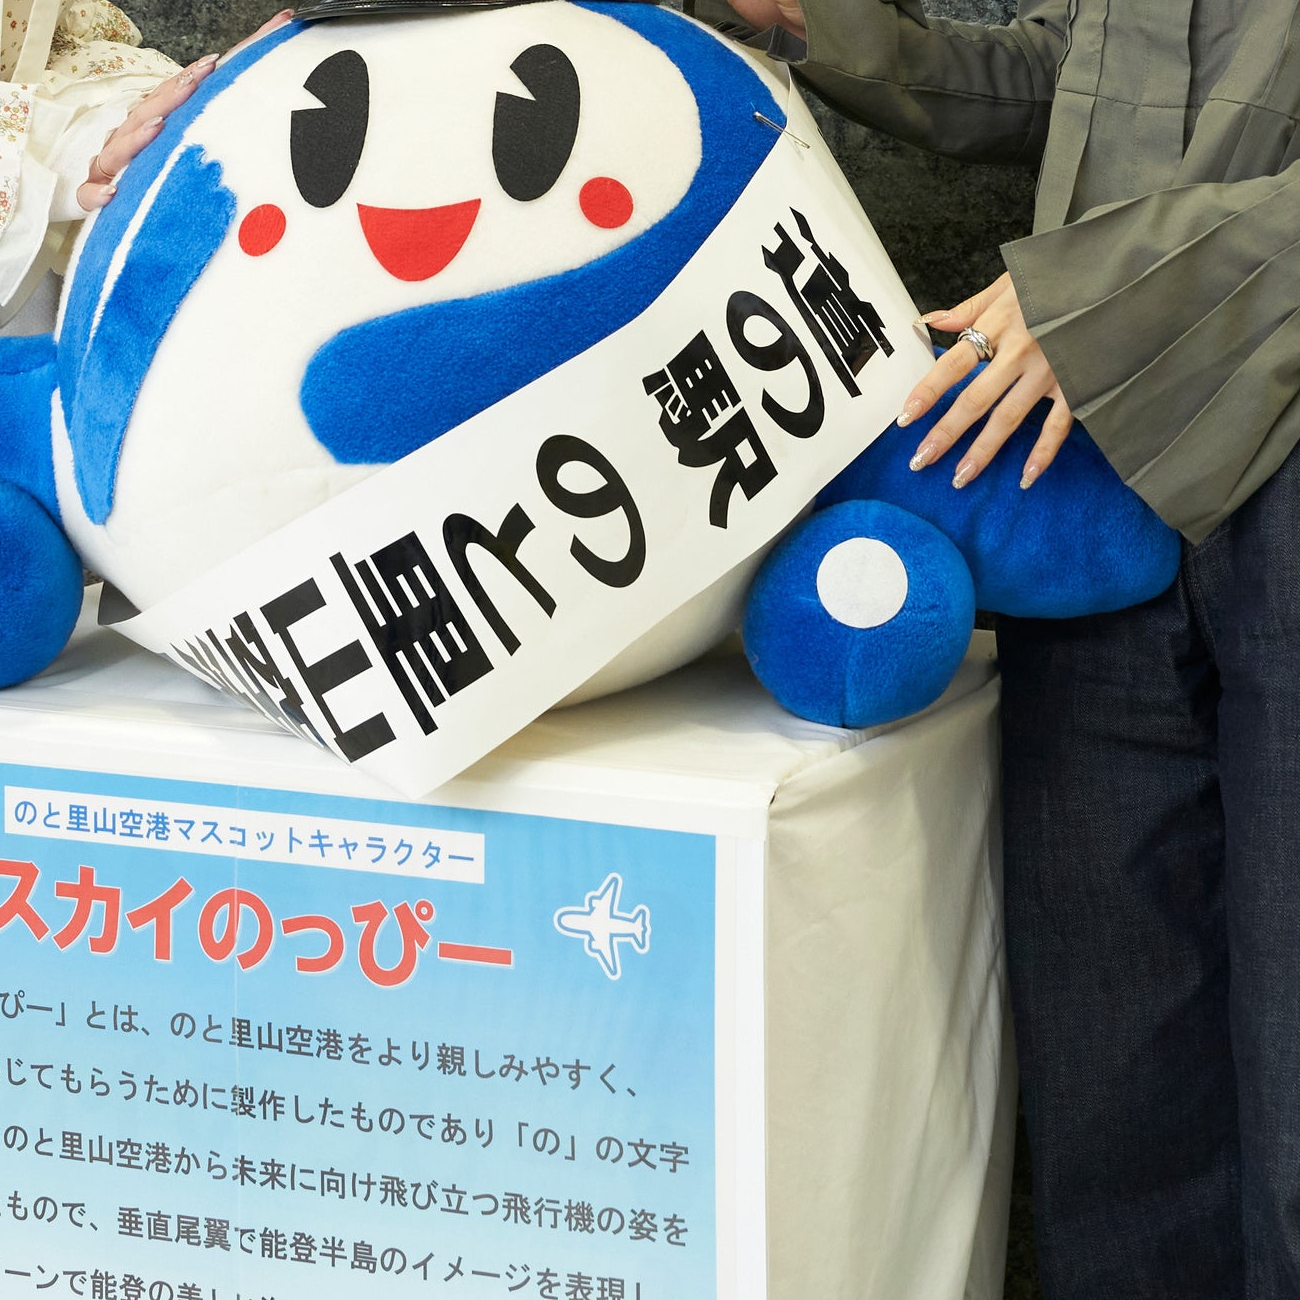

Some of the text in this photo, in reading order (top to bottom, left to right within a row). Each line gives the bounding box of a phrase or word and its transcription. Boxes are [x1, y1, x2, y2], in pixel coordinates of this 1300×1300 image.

[642, 206, 896, 529] 道の駅
[14, 800, 475, 869] のと里山空港マスコットキャラクター
